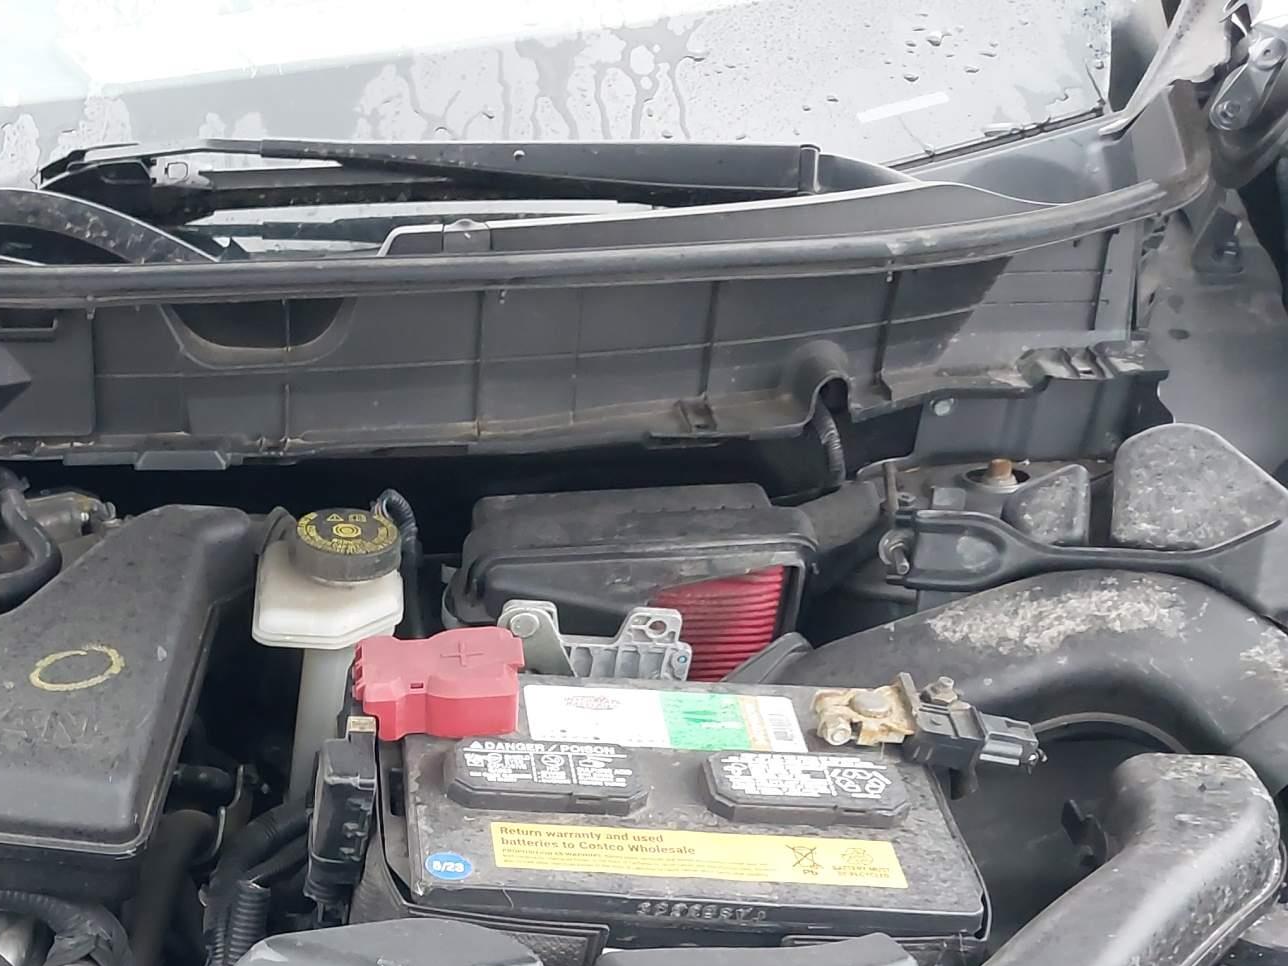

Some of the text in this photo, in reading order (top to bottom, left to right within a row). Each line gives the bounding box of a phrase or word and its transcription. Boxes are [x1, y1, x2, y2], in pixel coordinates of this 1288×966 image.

[485, 741, 544, 753] DANGER
[560, 744, 616, 755] POISON
[500, 826, 664, 843] Return warranty and used
[501, 836, 696, 855] batteries to Costco Wholesale
